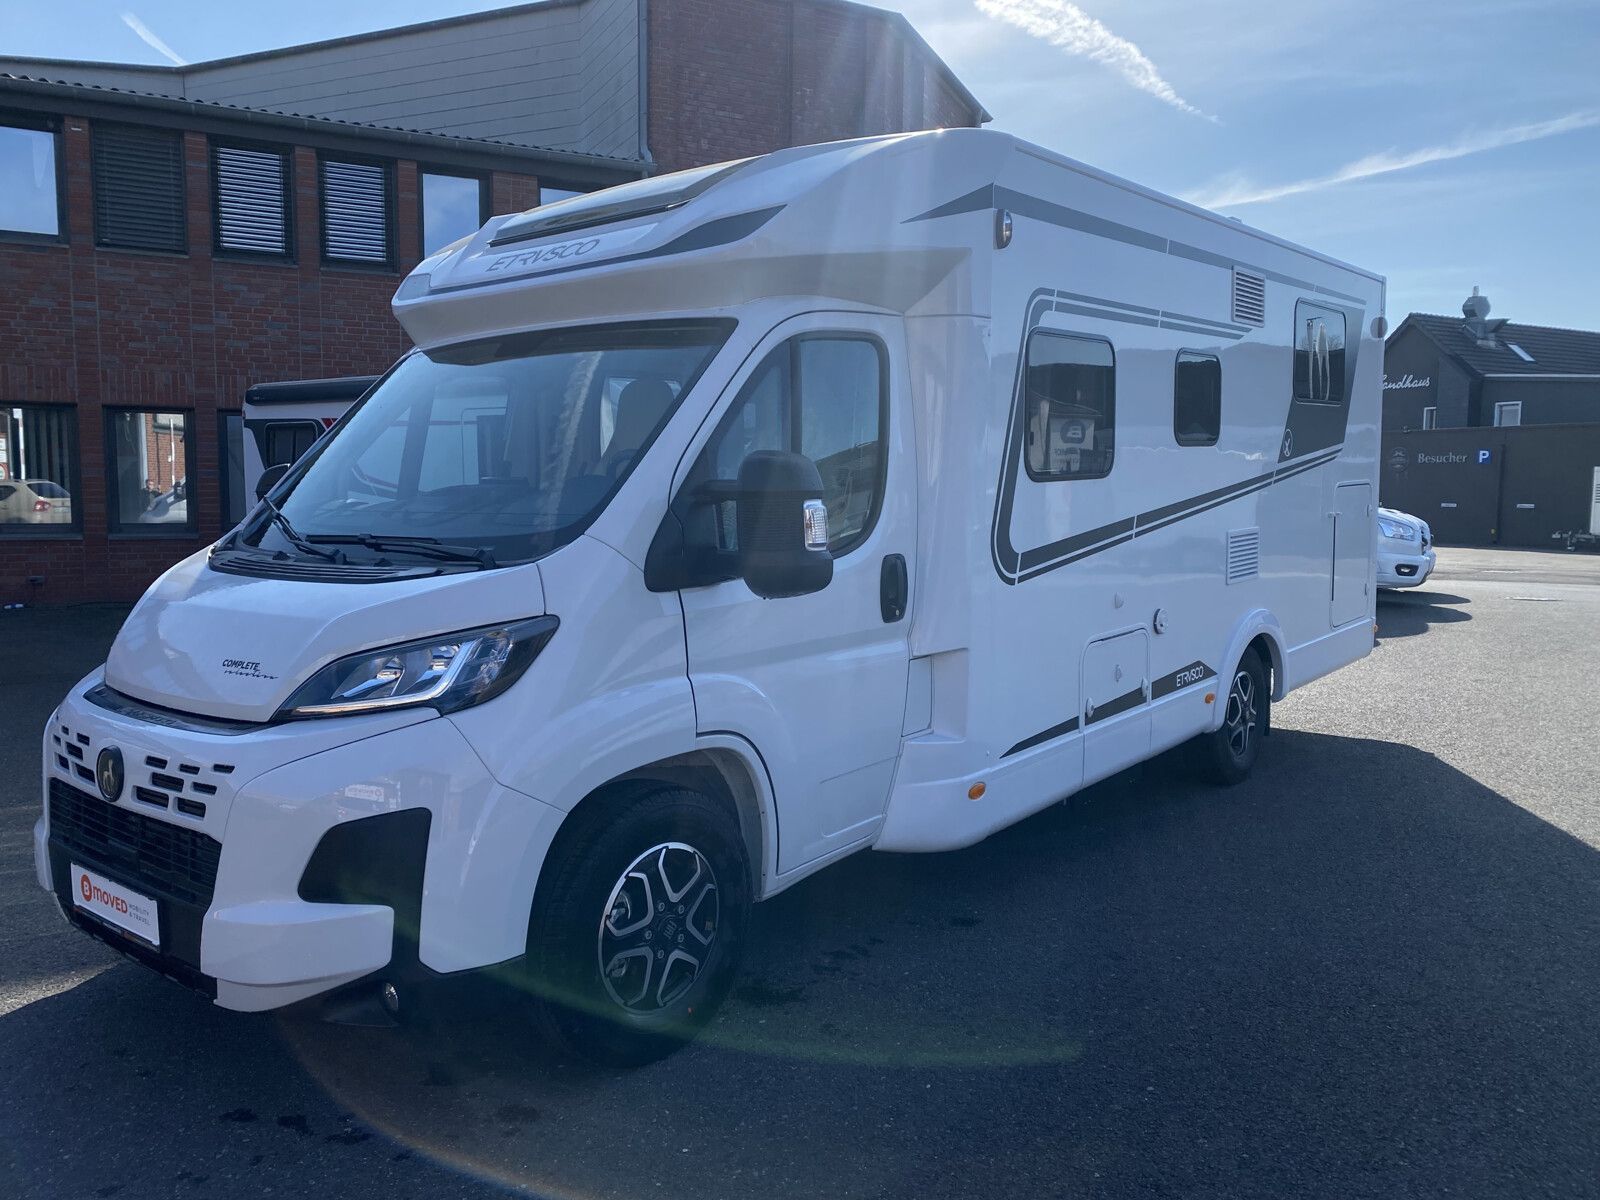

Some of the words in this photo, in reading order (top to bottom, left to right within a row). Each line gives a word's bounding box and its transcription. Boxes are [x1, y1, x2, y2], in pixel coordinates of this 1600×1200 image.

[1383, 374, 1430, 390] andhaus
[1418, 452, 1468, 464] Besucher
[1479, 450, 1490, 463] P
[222, 659, 260, 670] COMPLETE
